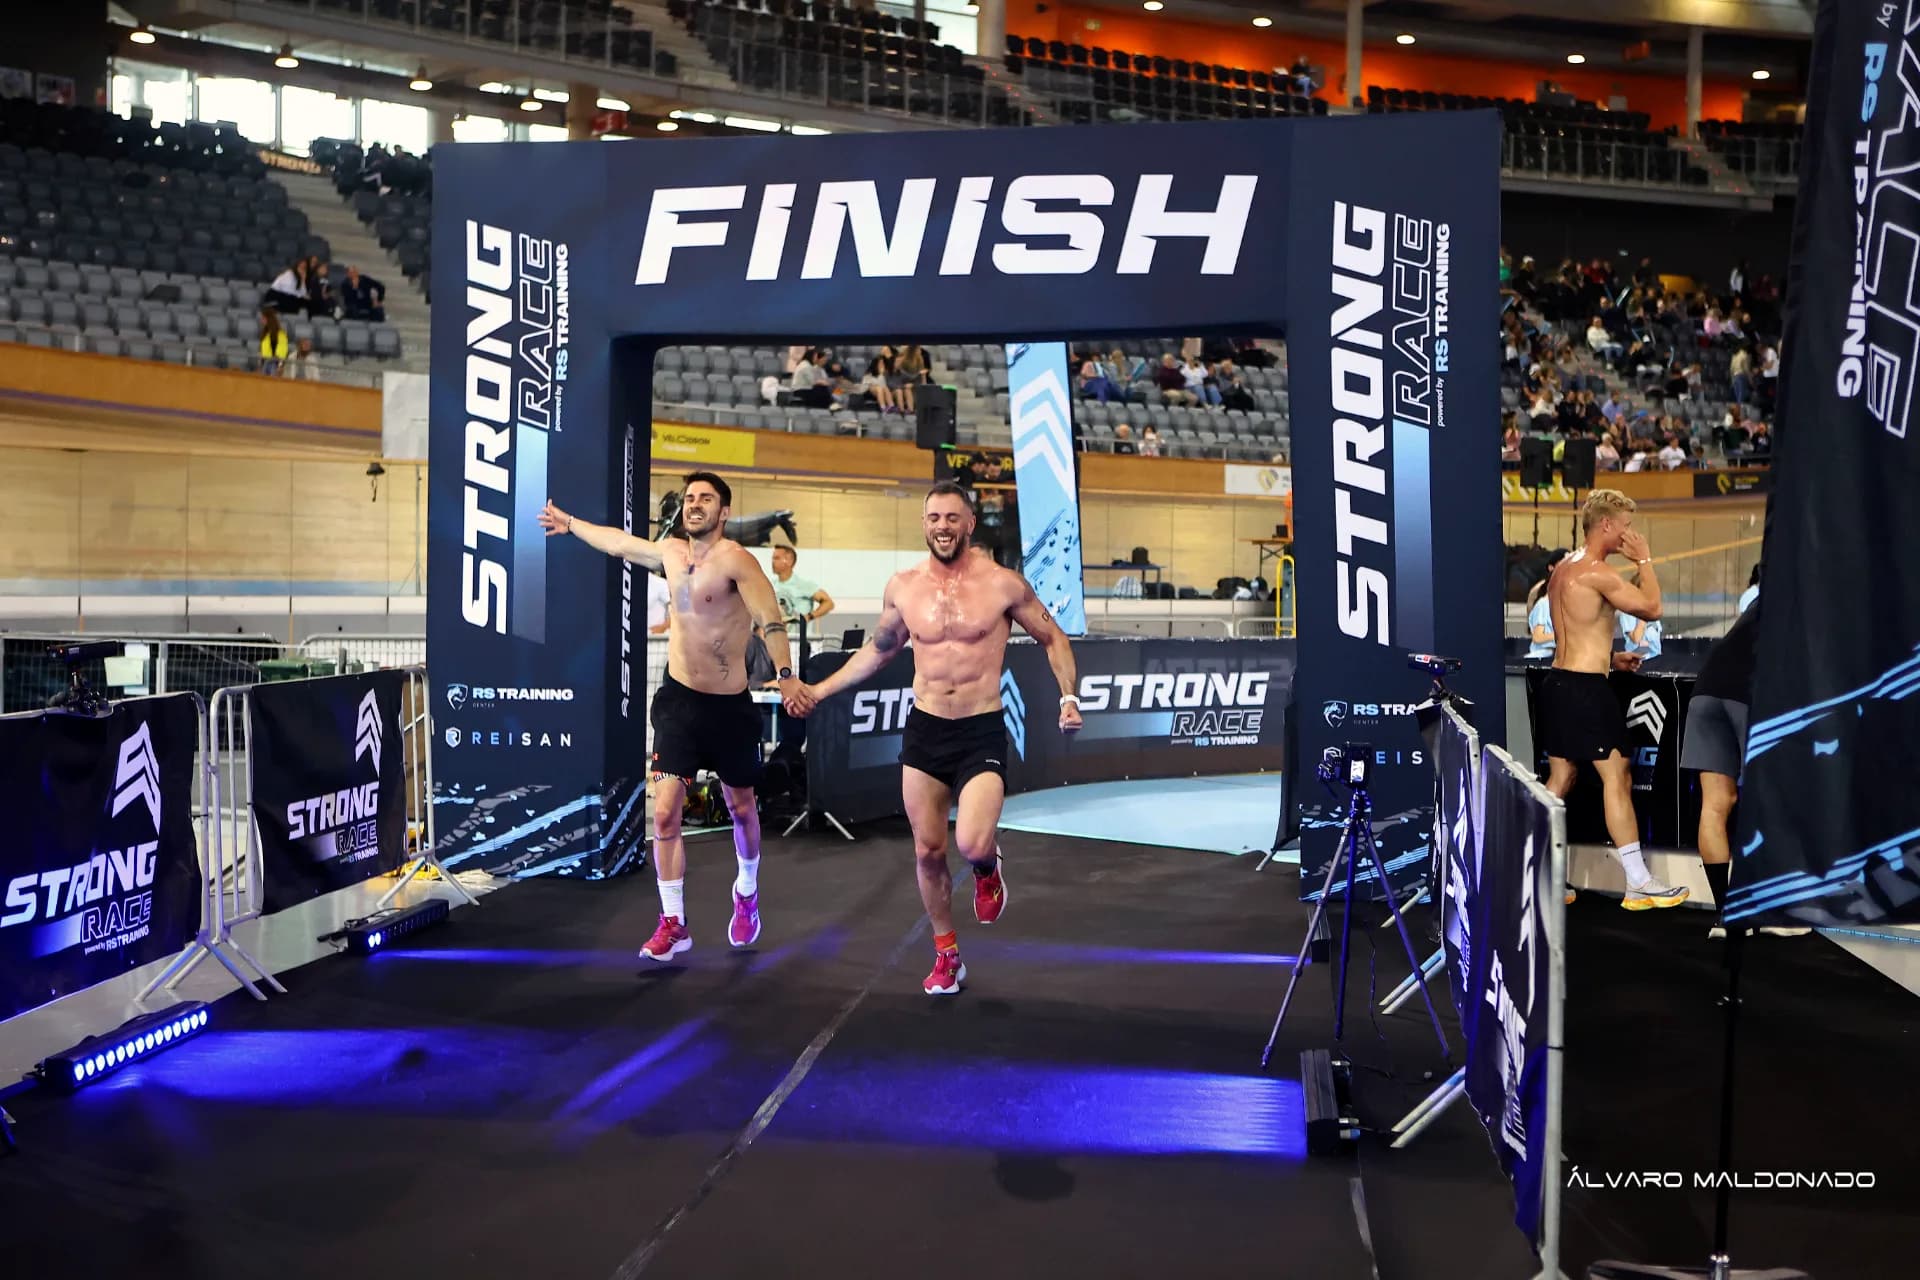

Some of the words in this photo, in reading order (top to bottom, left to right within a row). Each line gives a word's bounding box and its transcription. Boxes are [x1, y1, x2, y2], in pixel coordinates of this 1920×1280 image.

[1876, 2, 1899, 29] by
[1862, 42, 1888, 122] RS
[634, 173, 1259, 285] FINISH
[555, 243, 569, 348] TRAINING
[1434, 223, 1451, 337] TRAINING
[518, 233, 552, 429] RACE
[1392, 213, 1432, 425] RACE
[555, 350, 569, 381] RS
[1434, 338, 1450, 373] RS
[461, 219, 513, 635] STRONG
[1330, 200, 1390, 647] STRONG
[1437, 391, 1446, 427] powered
[620, 507, 632, 697] STROG
[472, 687, 496, 699] RS
[497, 688, 574, 701] TRAINING
[1078, 671, 1270, 711] STRONG
[1353, 703, 1379, 716] RS
[471, 731, 571, 747] REISAN
[1171, 709, 1263, 736] RACE
[1194, 736, 1209, 746] RS
[1210, 734, 1258, 746] TRAINING
[287, 781, 380, 841] STRONG
[335, 819, 378, 856] RACE
[0, 840, 159, 928] STRONG
[82, 889, 153, 943] RACE
[106, 937, 118, 952] RS
[117, 924, 149, 946] TRAINING
